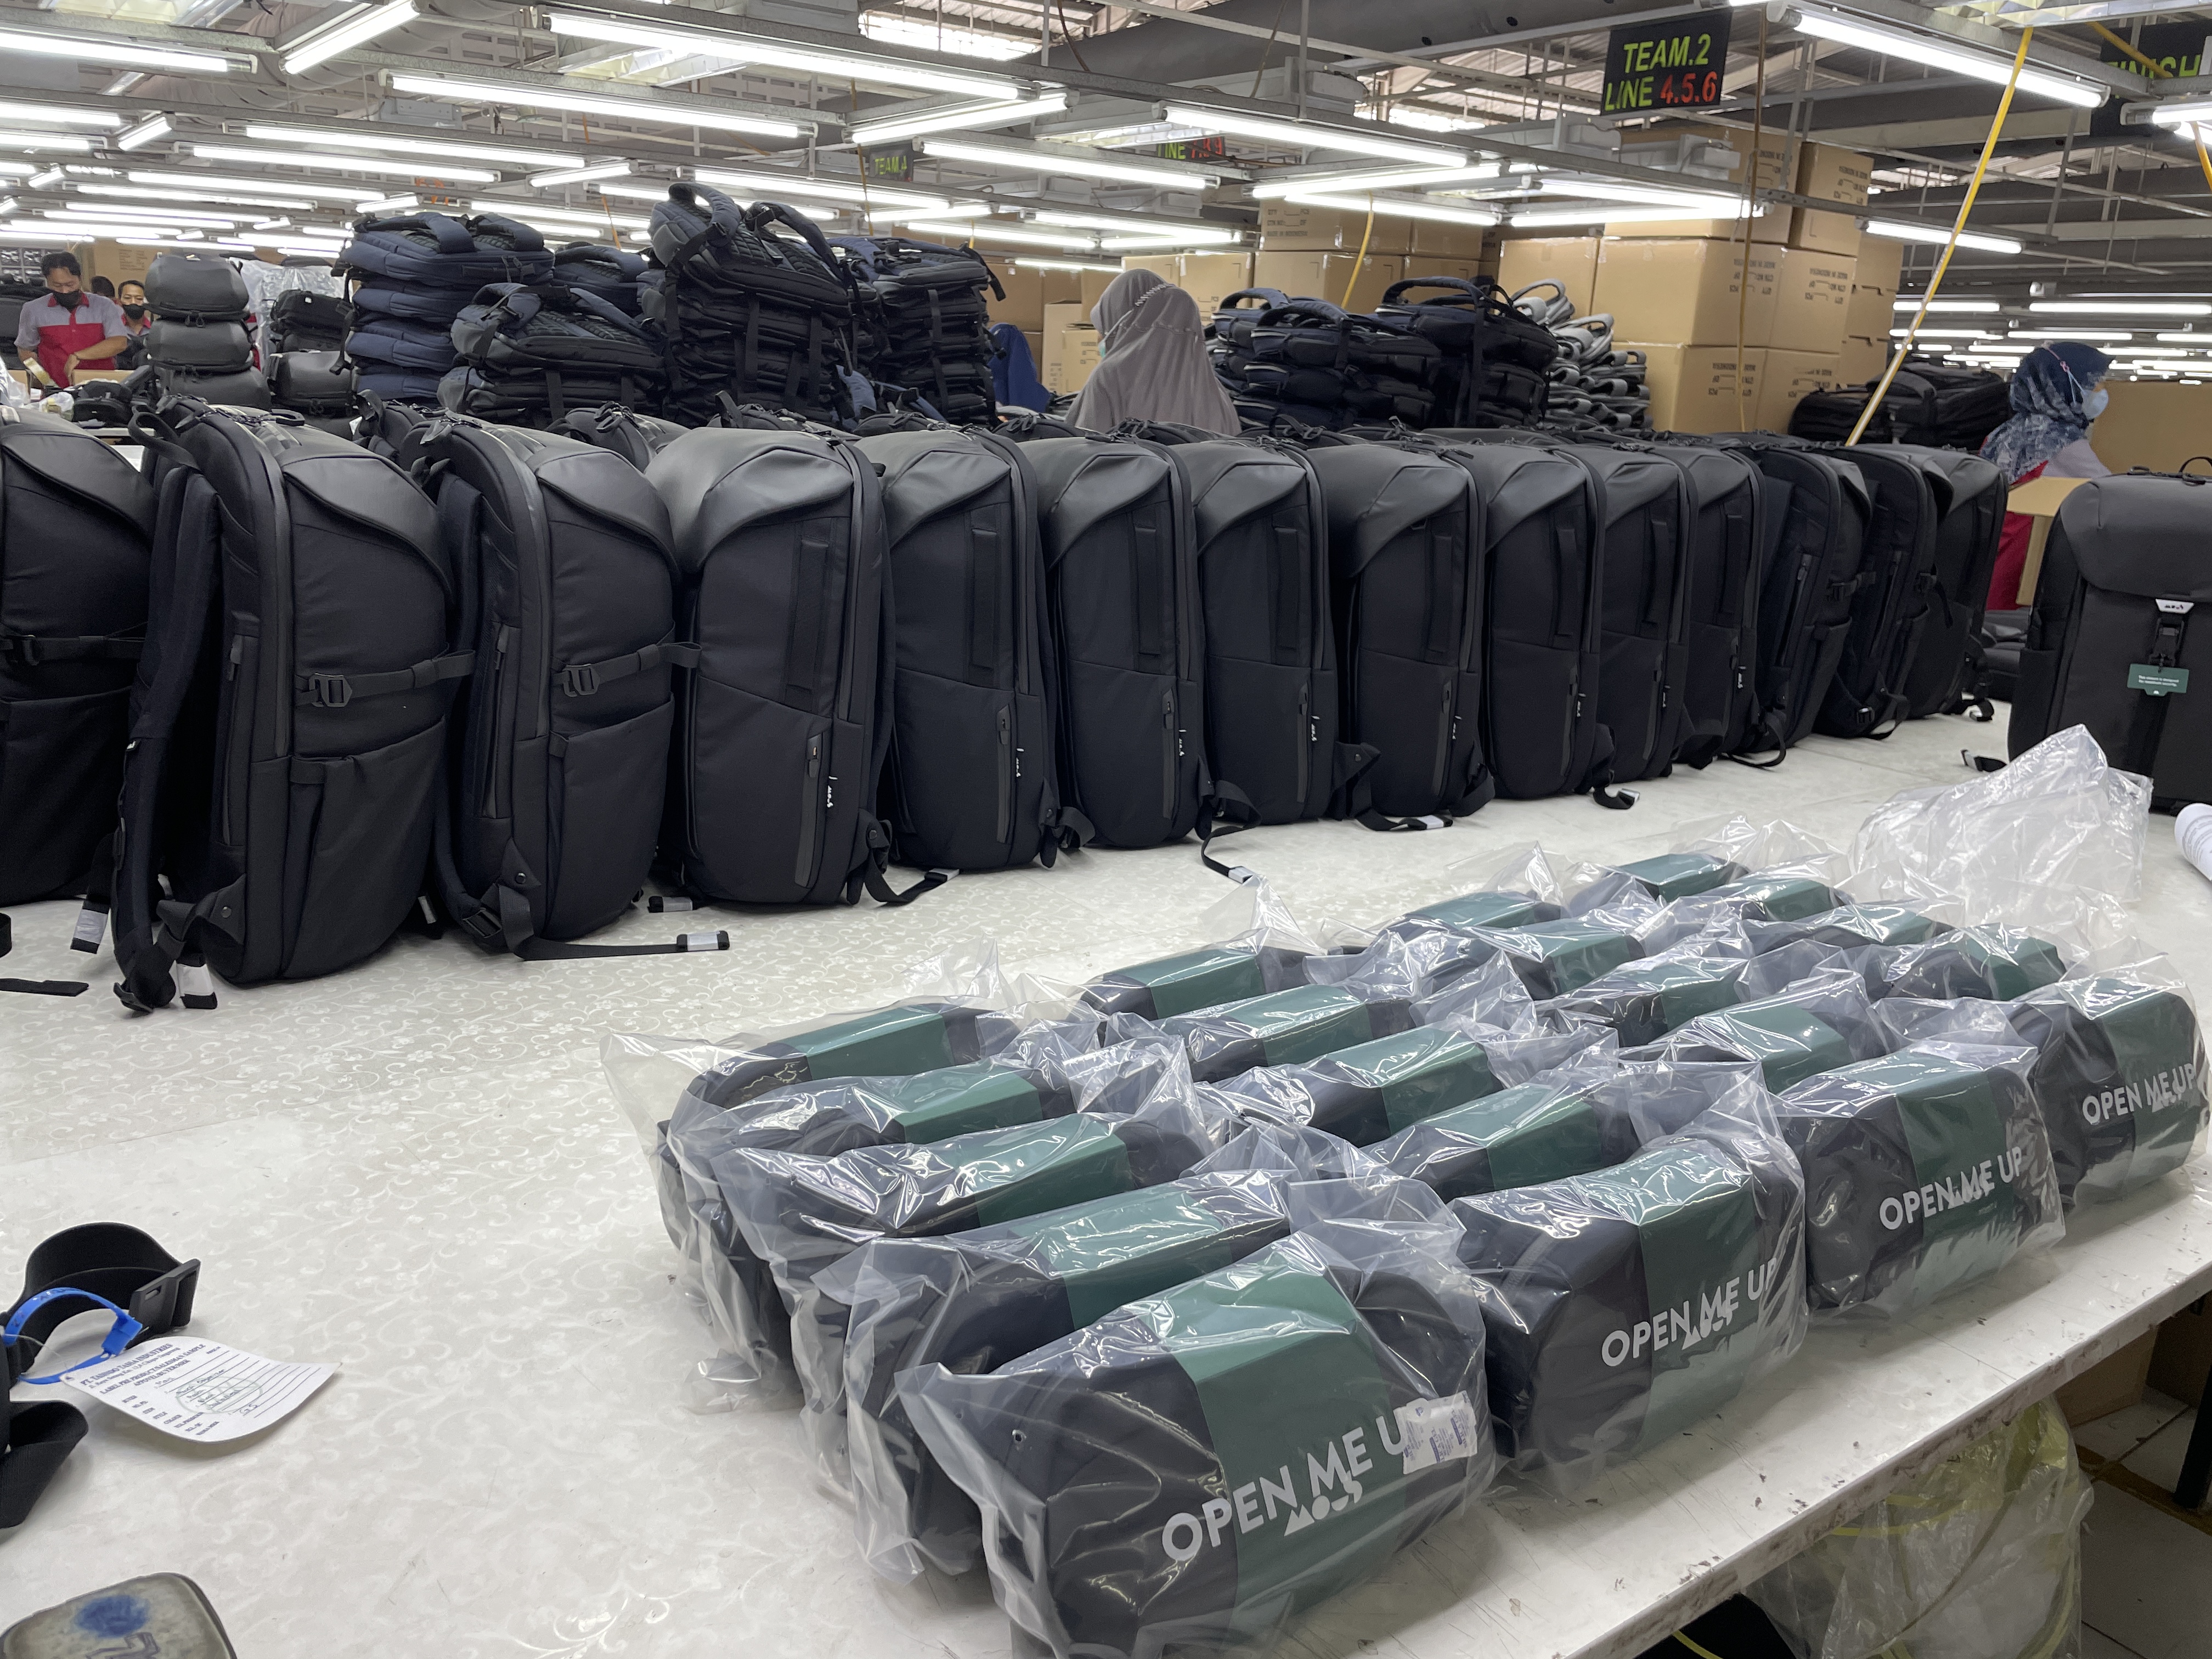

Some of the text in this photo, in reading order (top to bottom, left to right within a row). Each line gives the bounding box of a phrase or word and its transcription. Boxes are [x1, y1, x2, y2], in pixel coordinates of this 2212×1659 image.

[1624, 33, 1711, 74] TEAM.2
[1605, 71, 1717, 111] LINE 4.5.6
[2083, 1063, 2196, 1125] OPEN ME UP
[1880, 1146, 2022, 1230] OPEN ME UP
[1601, 1257, 1778, 1367] OPEN ME UP
[99, 1384, 121, 1394] LABEL
[183, 1344, 206, 1356] SAMPLE
[116, 1360, 139, 1369] TASSA
[135, 1344, 173, 1361] INDUSTRIES
[1162, 1465, 1297, 1561] OPEN
[1307, 1426, 1373, 1498] ME
